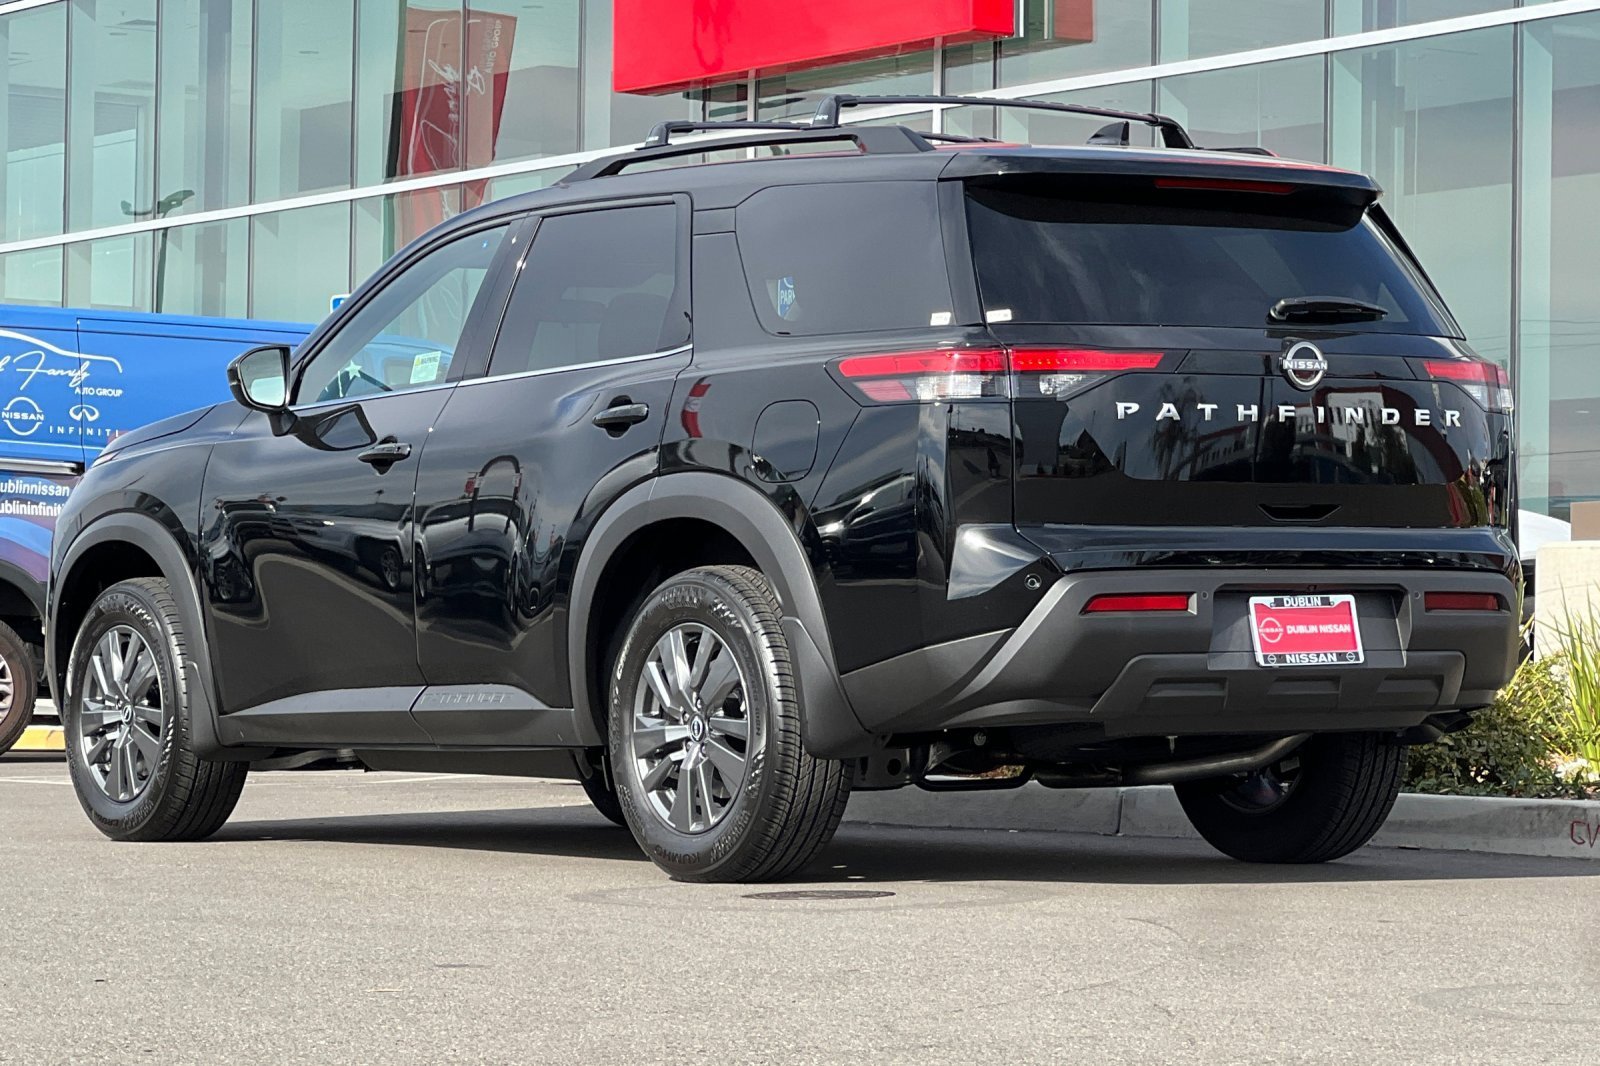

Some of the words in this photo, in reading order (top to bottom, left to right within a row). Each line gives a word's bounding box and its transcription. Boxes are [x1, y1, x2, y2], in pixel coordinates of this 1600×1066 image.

[1282, 358, 1328, 370] NISSAN
[74, 386, 95, 396] AUTO
[95, 388, 123, 397] GROUP
[1, 411, 44, 421] NISSAN
[1116, 400, 1461, 427] PATHFINDER
[49, 425, 119, 438] INFINITI
[1283, 597, 1321, 607] DUBLIN
[1286, 624, 1319, 635] DUBLIN
[1318, 623, 1351, 634] NISSAN
[1285, 652, 1337, 664] NISSAN
